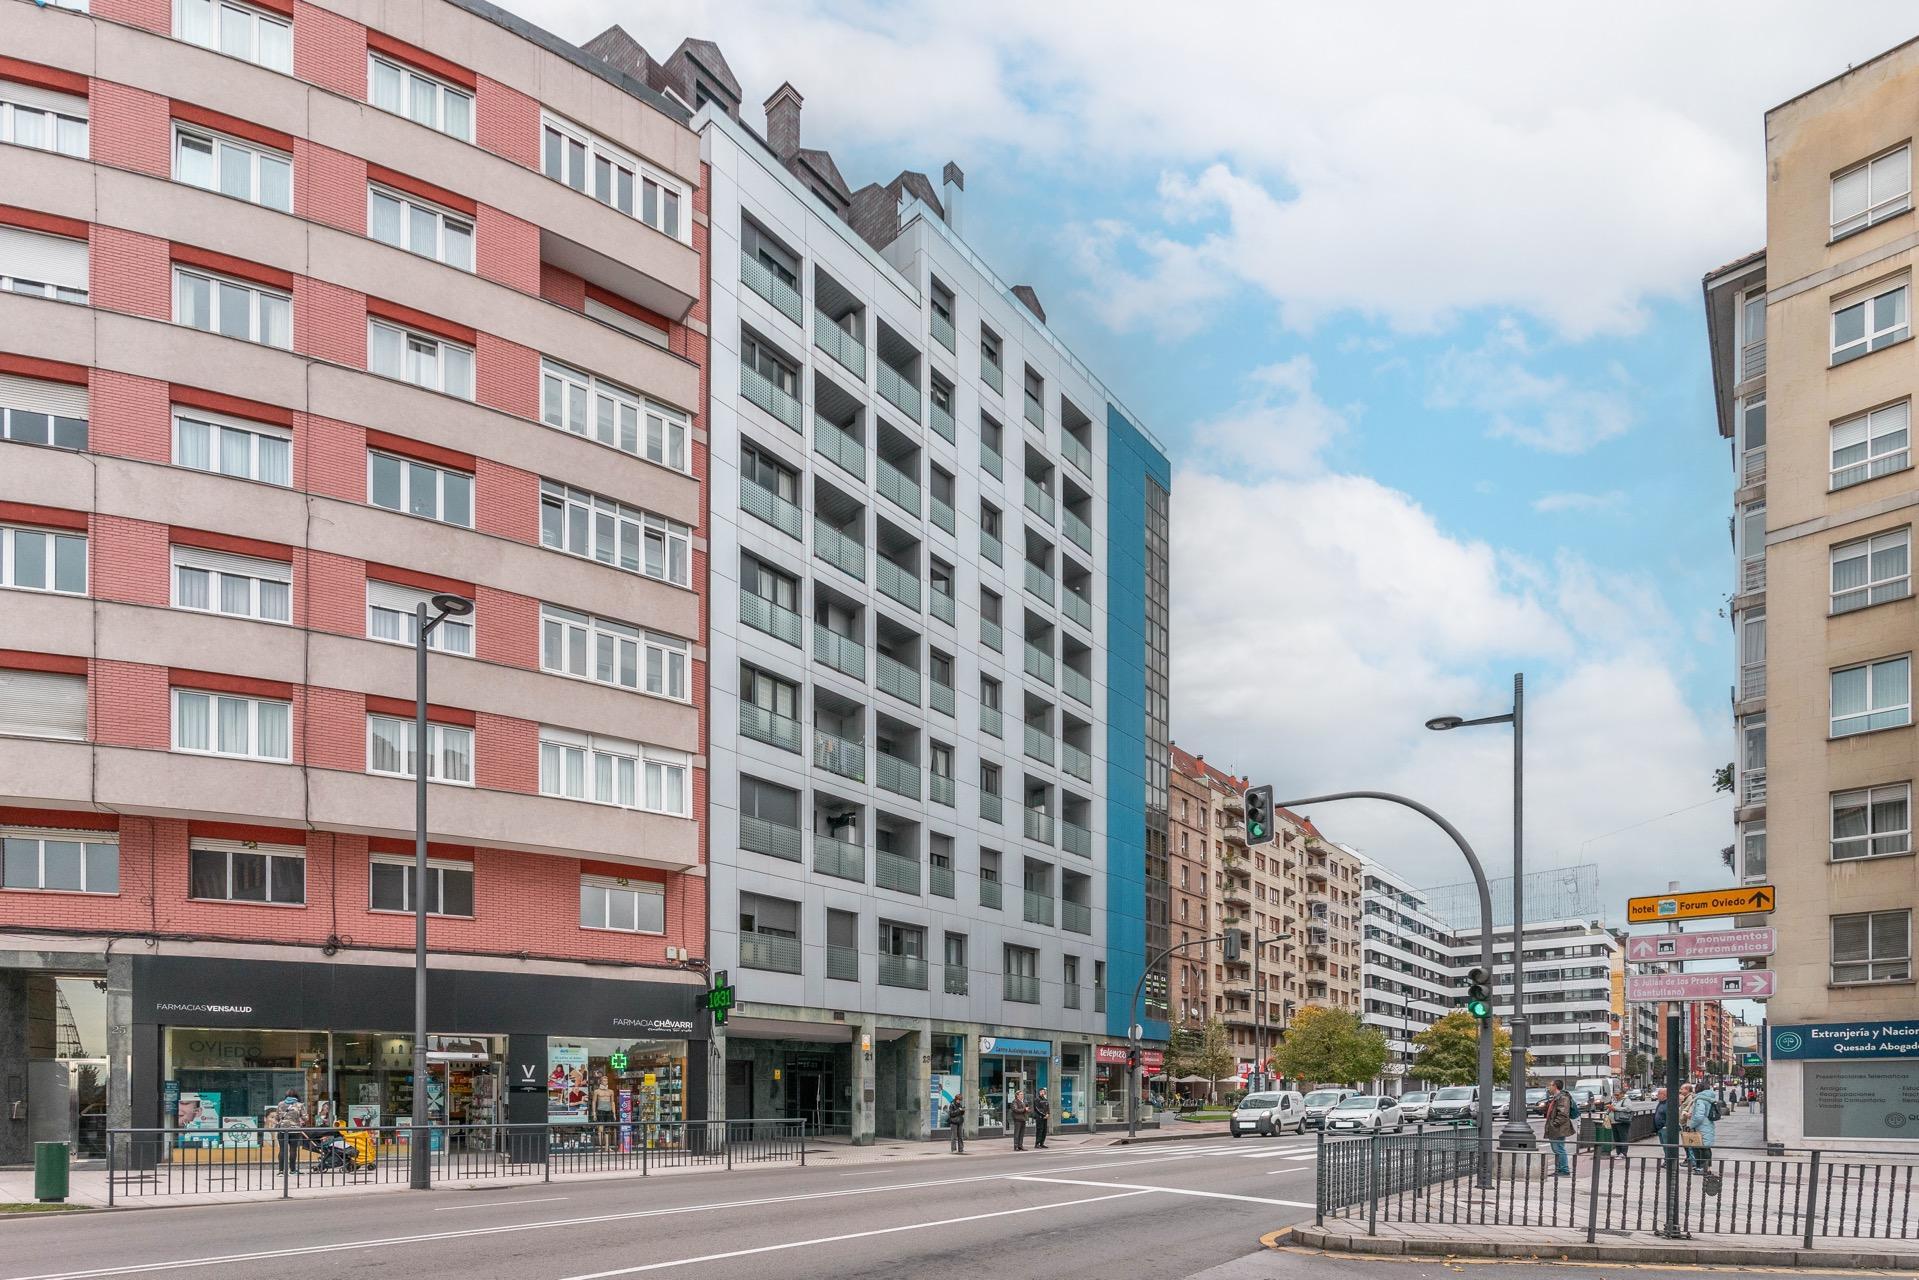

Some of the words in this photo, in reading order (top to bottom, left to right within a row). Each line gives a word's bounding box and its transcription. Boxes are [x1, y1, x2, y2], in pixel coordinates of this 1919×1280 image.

[1632, 905, 1655, 914] hotel
[1680, 902, 1708, 911] Forum
[1711, 898, 1746, 908] Oviedo
[1696, 931, 1769, 944] monumentos
[1665, 978, 1675, 986] de
[1677, 977, 1689, 985] los
[1691, 976, 1718, 985] Prados
[111, 1025, 127, 1036] 25
[1811, 1027, 1870, 1041] Extranjería
[1872, 1030, 1880, 1040] y
[189, 1040, 262, 1058] OVIEDO
[1833, 1043, 1876, 1053] Quesada
[1879, 1041, 1919, 1053] Abogad
[864, 1052, 873, 1061] 21
